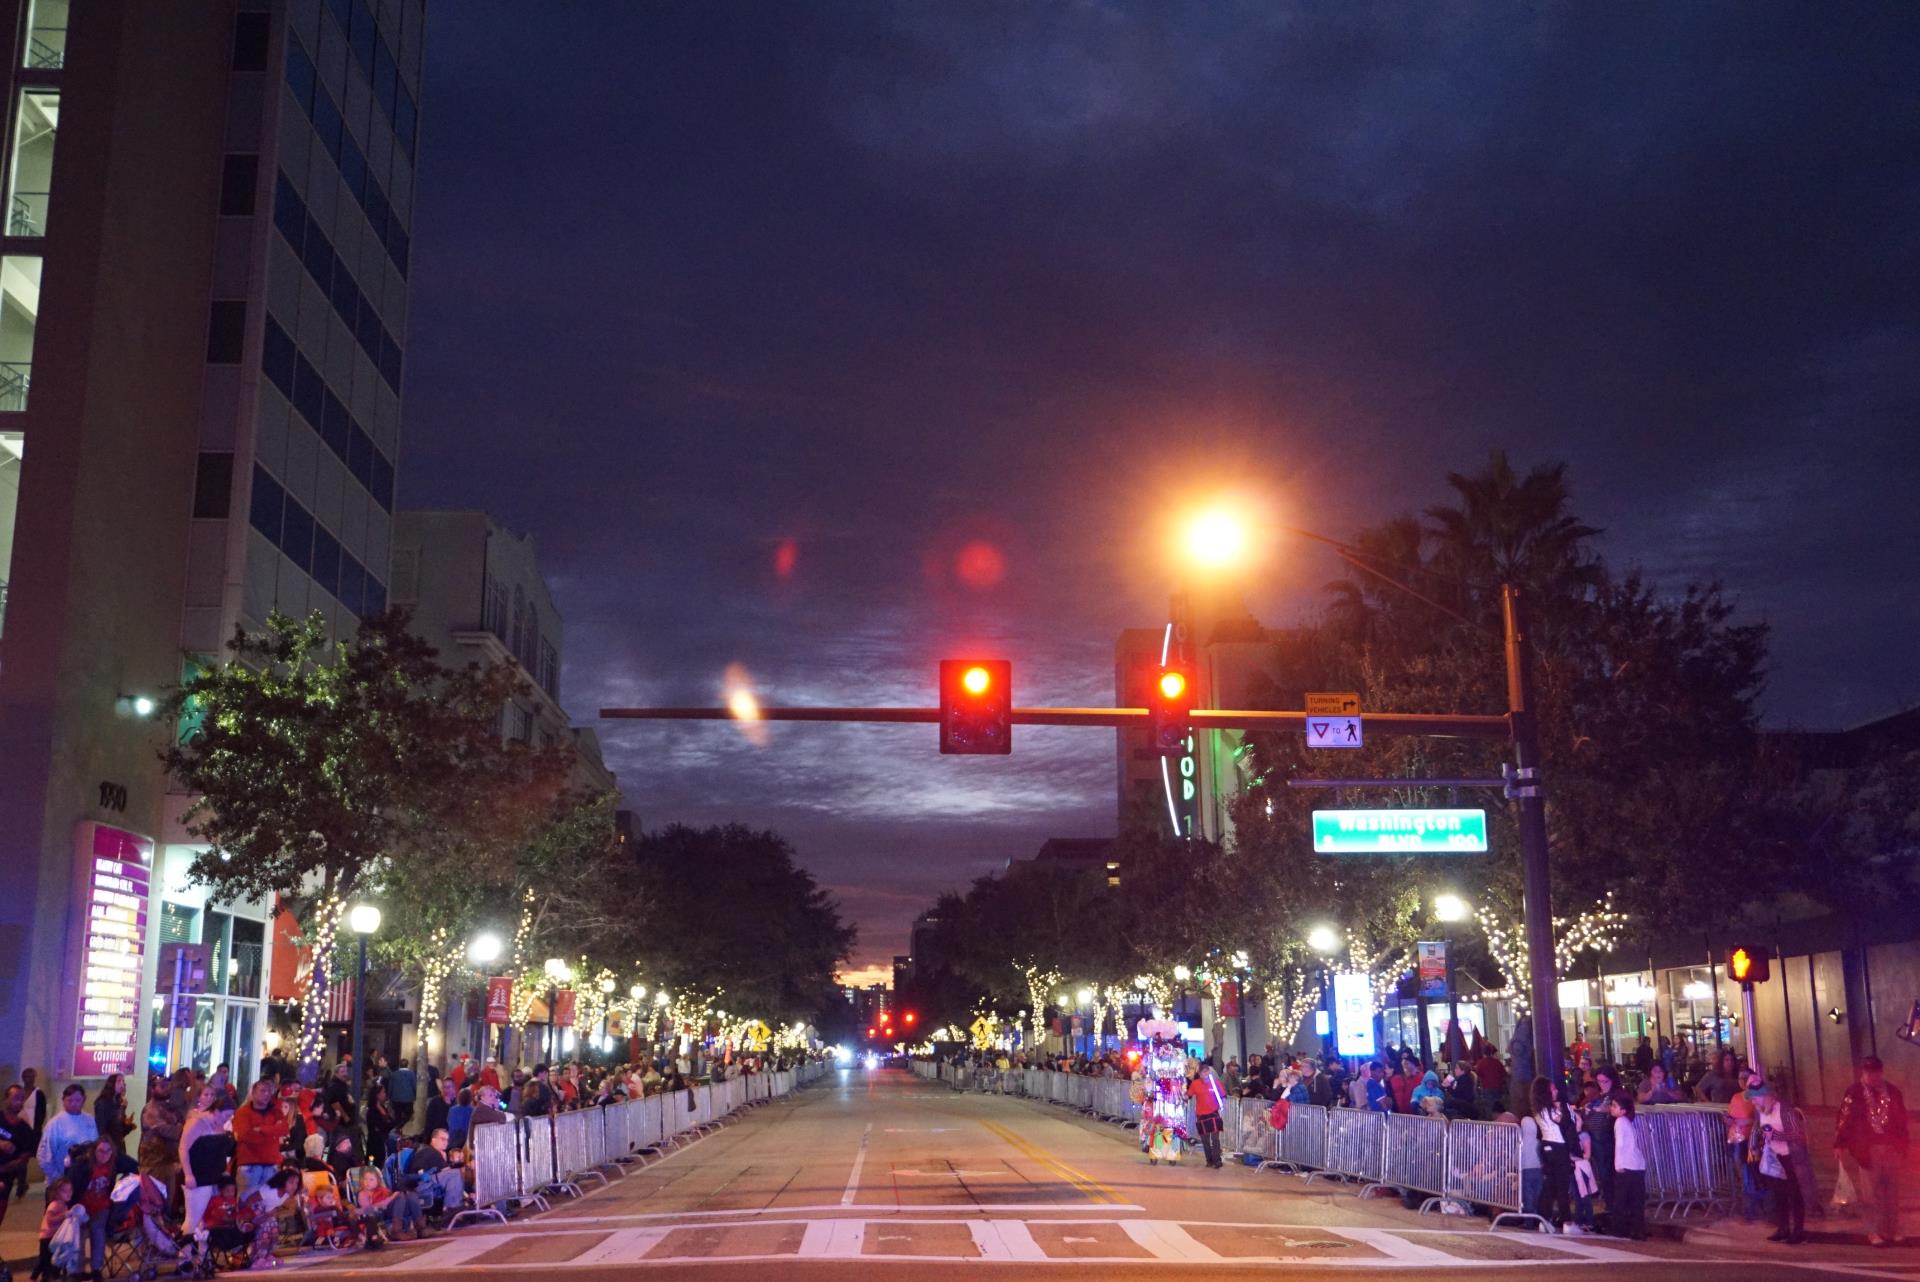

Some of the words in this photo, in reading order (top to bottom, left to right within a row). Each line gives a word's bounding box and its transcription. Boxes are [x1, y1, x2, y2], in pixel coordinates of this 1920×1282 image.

[1309, 697, 1340, 705] TURNING
[1309, 706, 1342, 714] VEHICLES
[1332, 727, 1341, 735] TO
[1338, 814, 1460, 835] Washington
[1378, 835, 1422, 849] BLVD
[1448, 835, 1478, 849] 100
[1344, 998, 1363, 1013] 15
